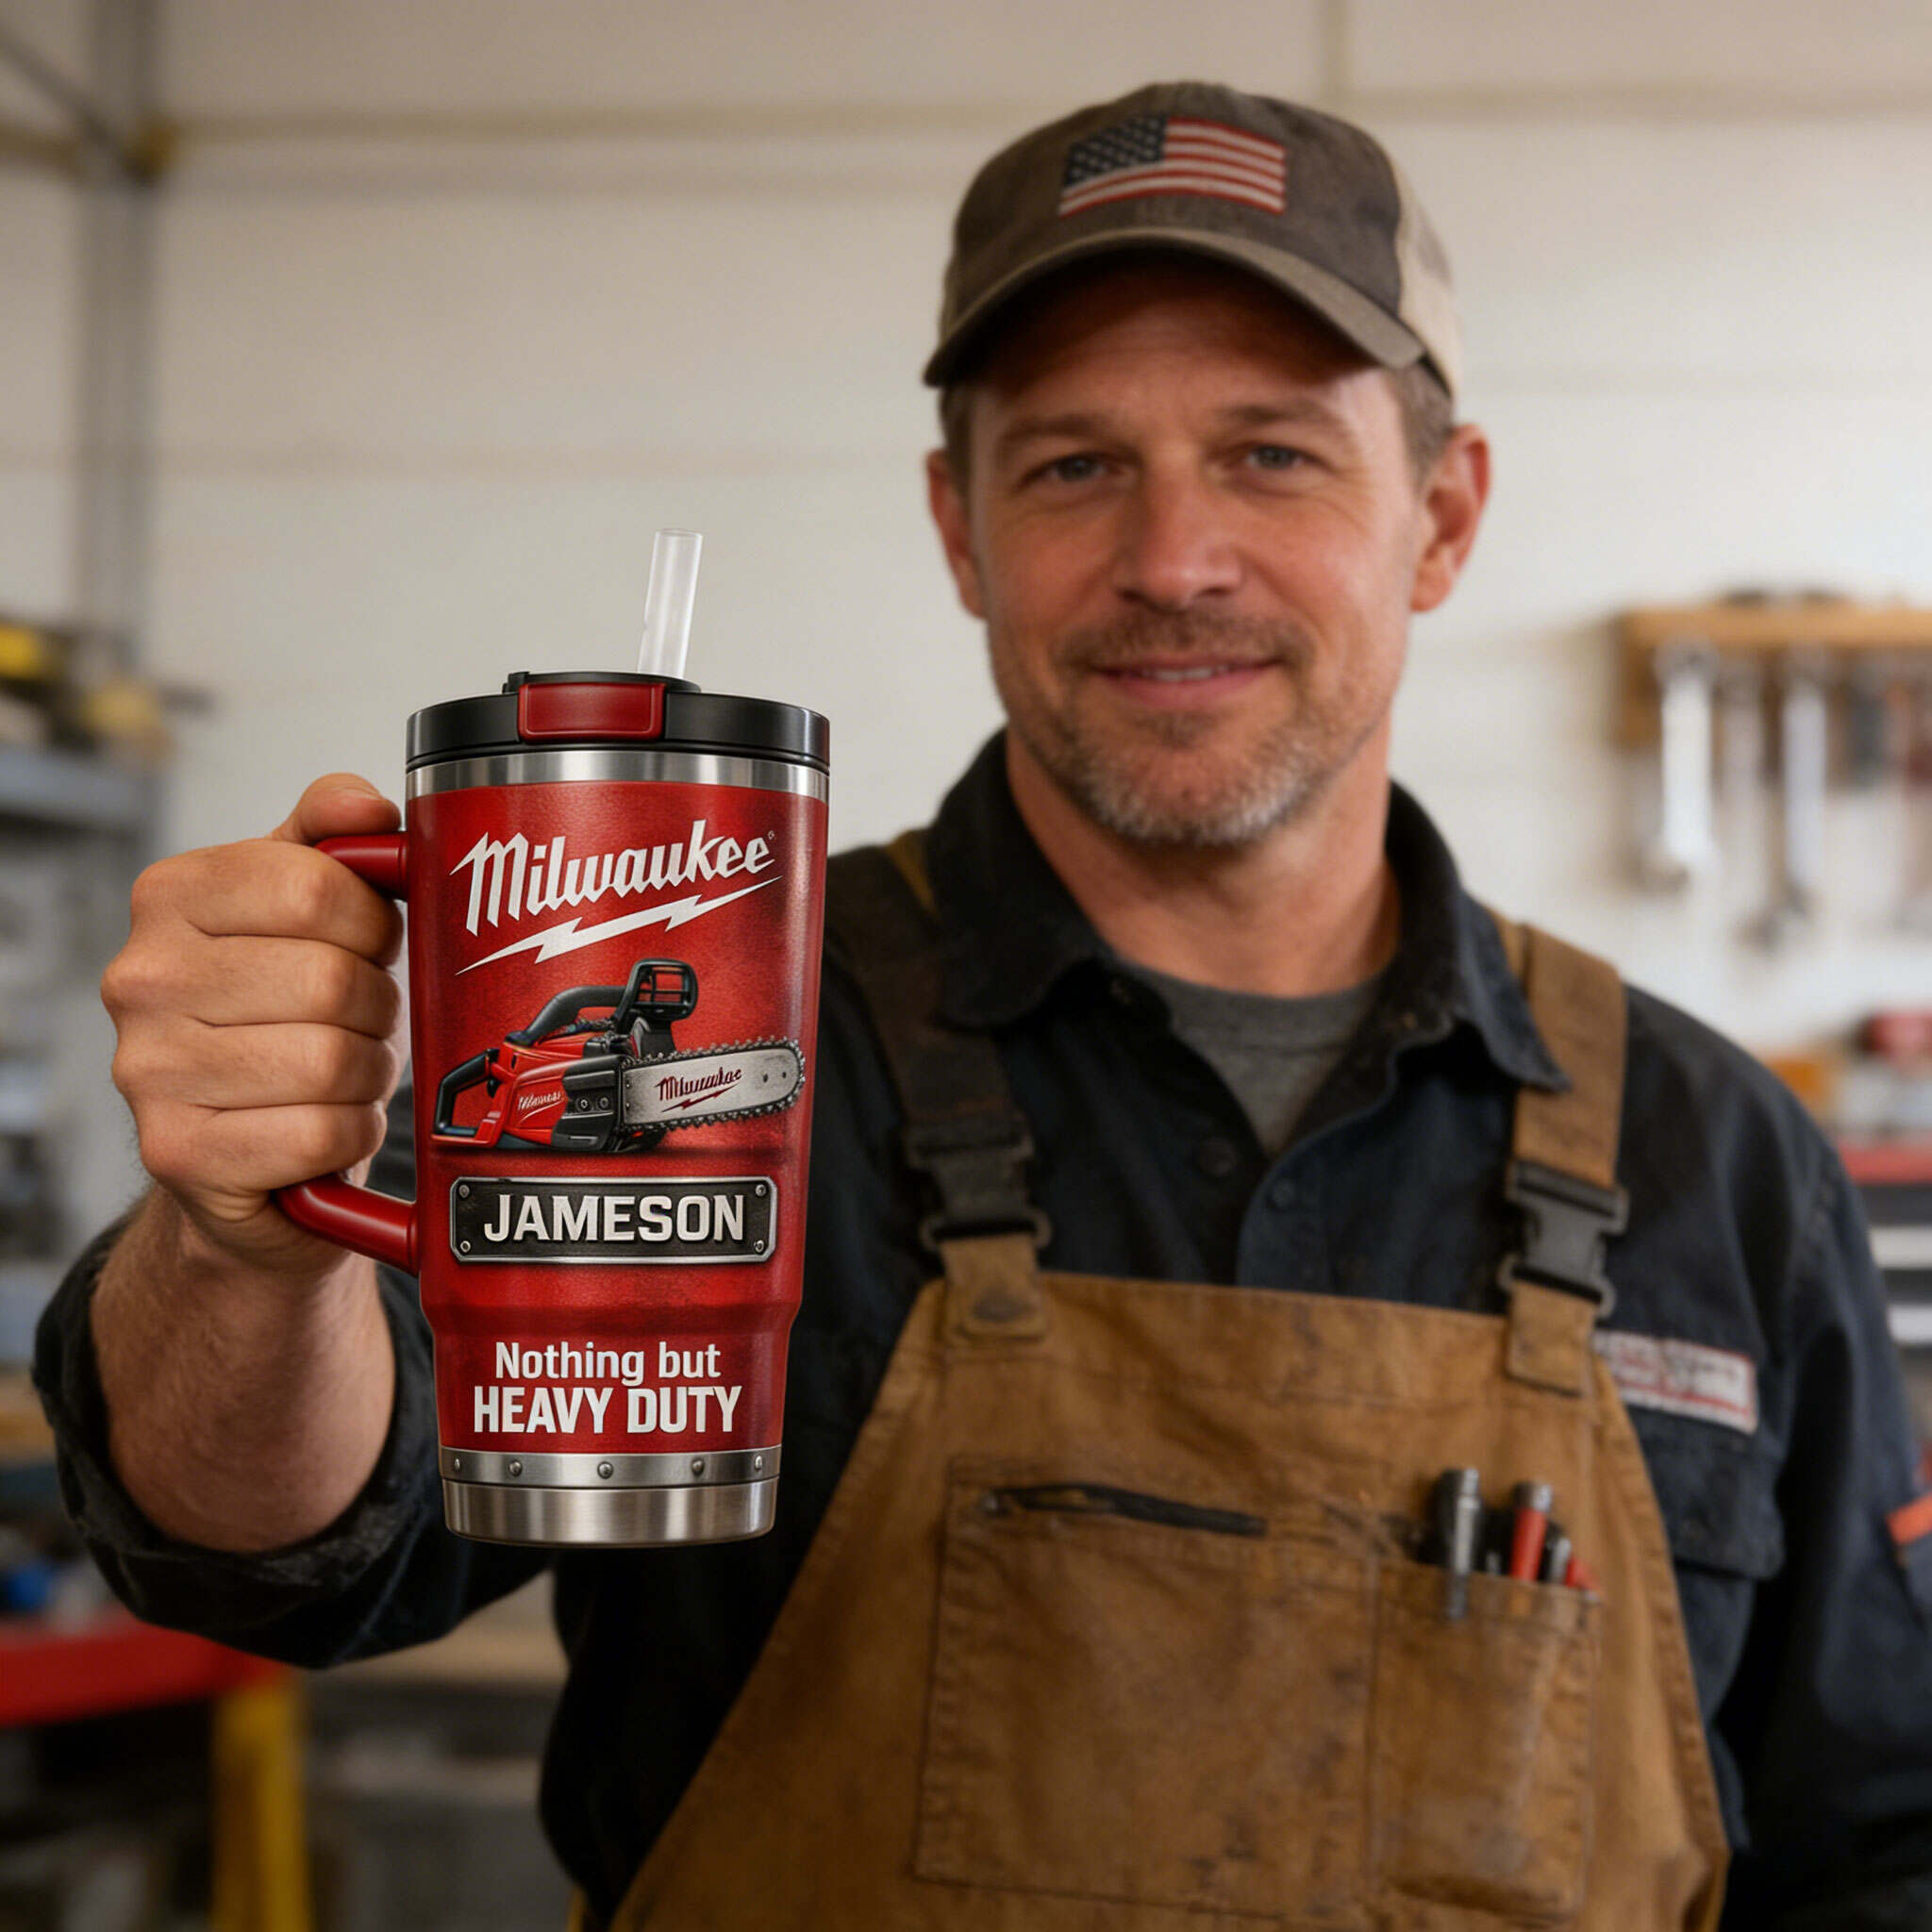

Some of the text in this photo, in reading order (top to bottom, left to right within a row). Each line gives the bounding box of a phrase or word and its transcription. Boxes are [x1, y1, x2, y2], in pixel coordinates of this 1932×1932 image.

[449, 819, 775, 937] Milwaukee
[484, 1193, 744, 1241] JAMESON
[495, 1341, 721, 1386] Nothing but
[474, 1385, 742, 1434] HEAVY DUTY
